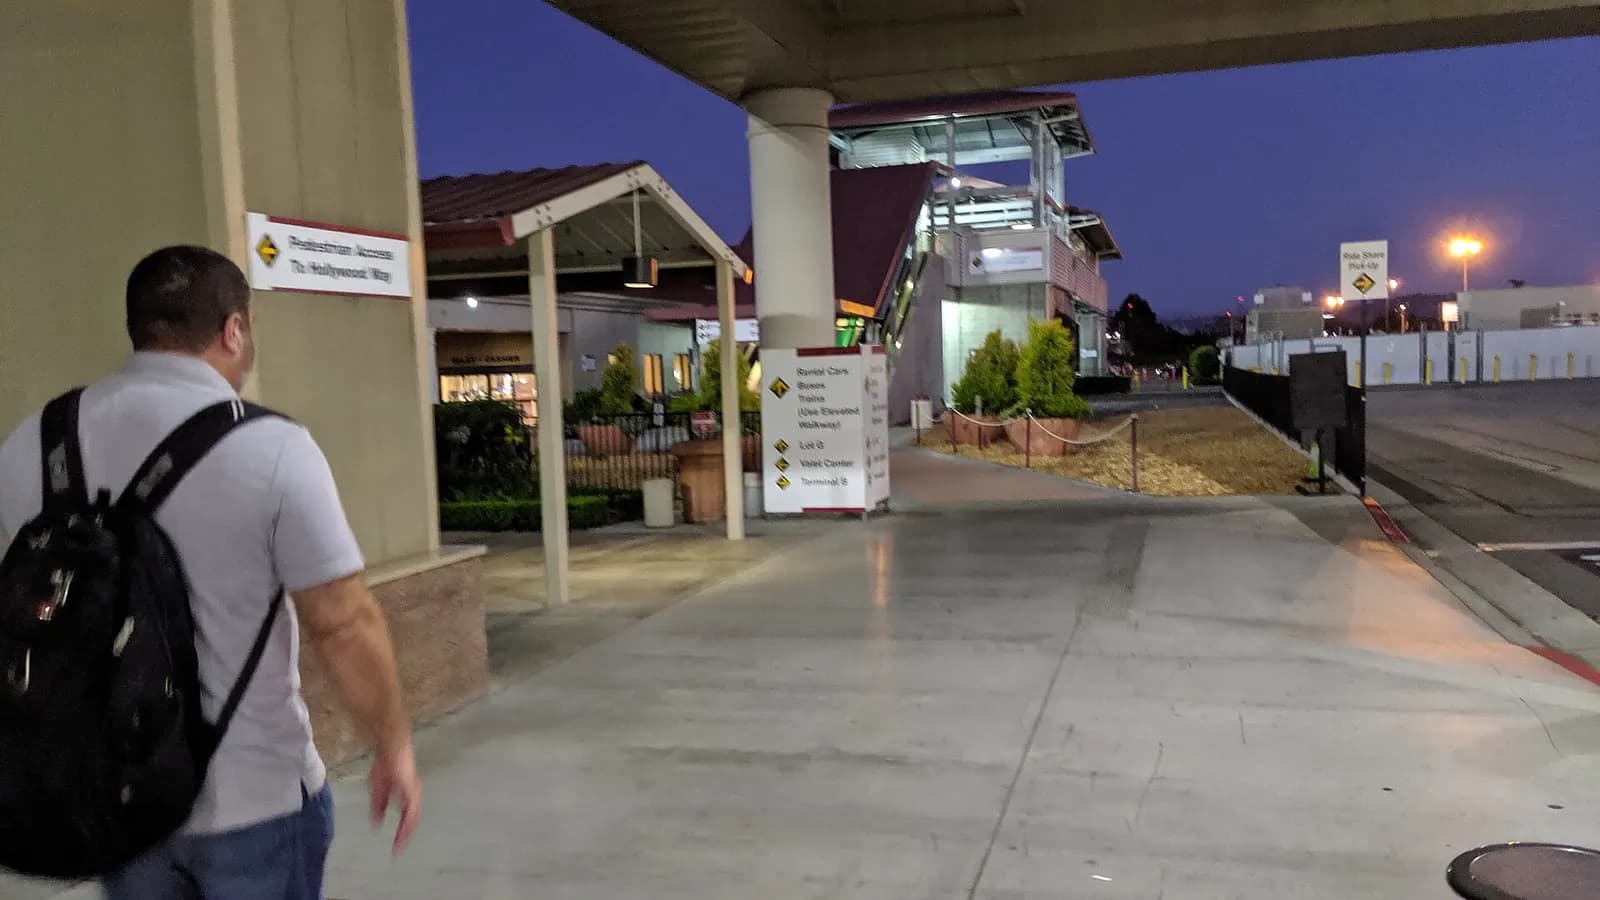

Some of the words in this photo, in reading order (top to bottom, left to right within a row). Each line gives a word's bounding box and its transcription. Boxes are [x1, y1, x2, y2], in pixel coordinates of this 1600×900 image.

[288, 235, 352, 255] Pedestrian
[356, 244, 394, 260] Access
[290, 259, 304, 274] To
[309, 261, 368, 279] Hollywood
[796, 367, 824, 376] Rental
[827, 366, 849, 376] Cars
[797, 381, 826, 390] Buses
[798, 394, 825, 403] Trains
[820, 407, 860, 416] Elevated
[800, 440, 814, 450] Lot
[800, 459, 822, 468] Valet
[824, 459, 853, 468] Center
[801, 477, 838, 487] Terminal
